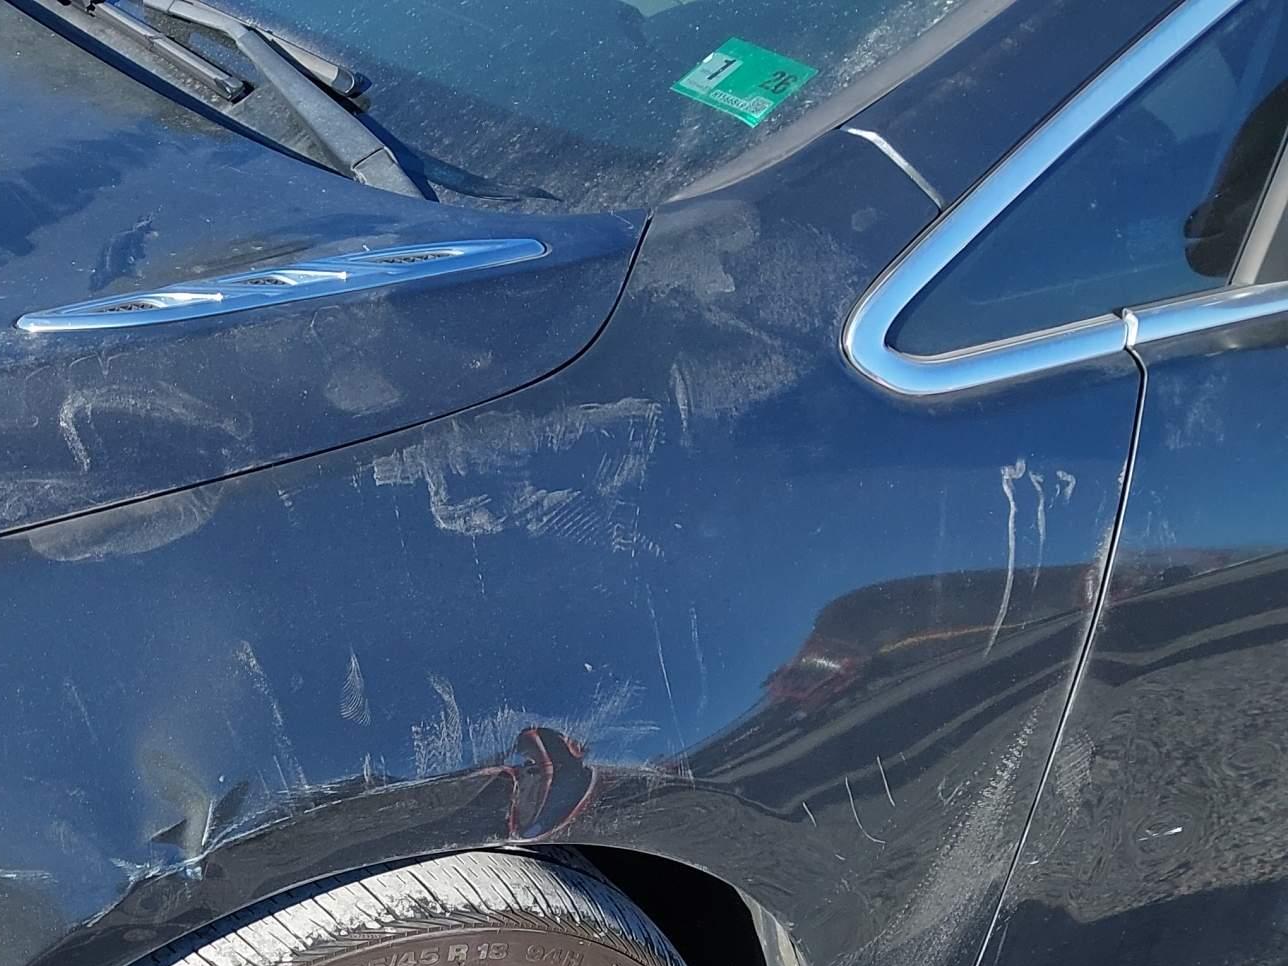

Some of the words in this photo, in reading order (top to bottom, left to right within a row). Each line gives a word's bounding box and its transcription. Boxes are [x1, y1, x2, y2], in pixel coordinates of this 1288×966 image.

[759, 70, 798, 94] 26
[448, 943, 469, 962] R
[477, 943, 508, 960] 18
